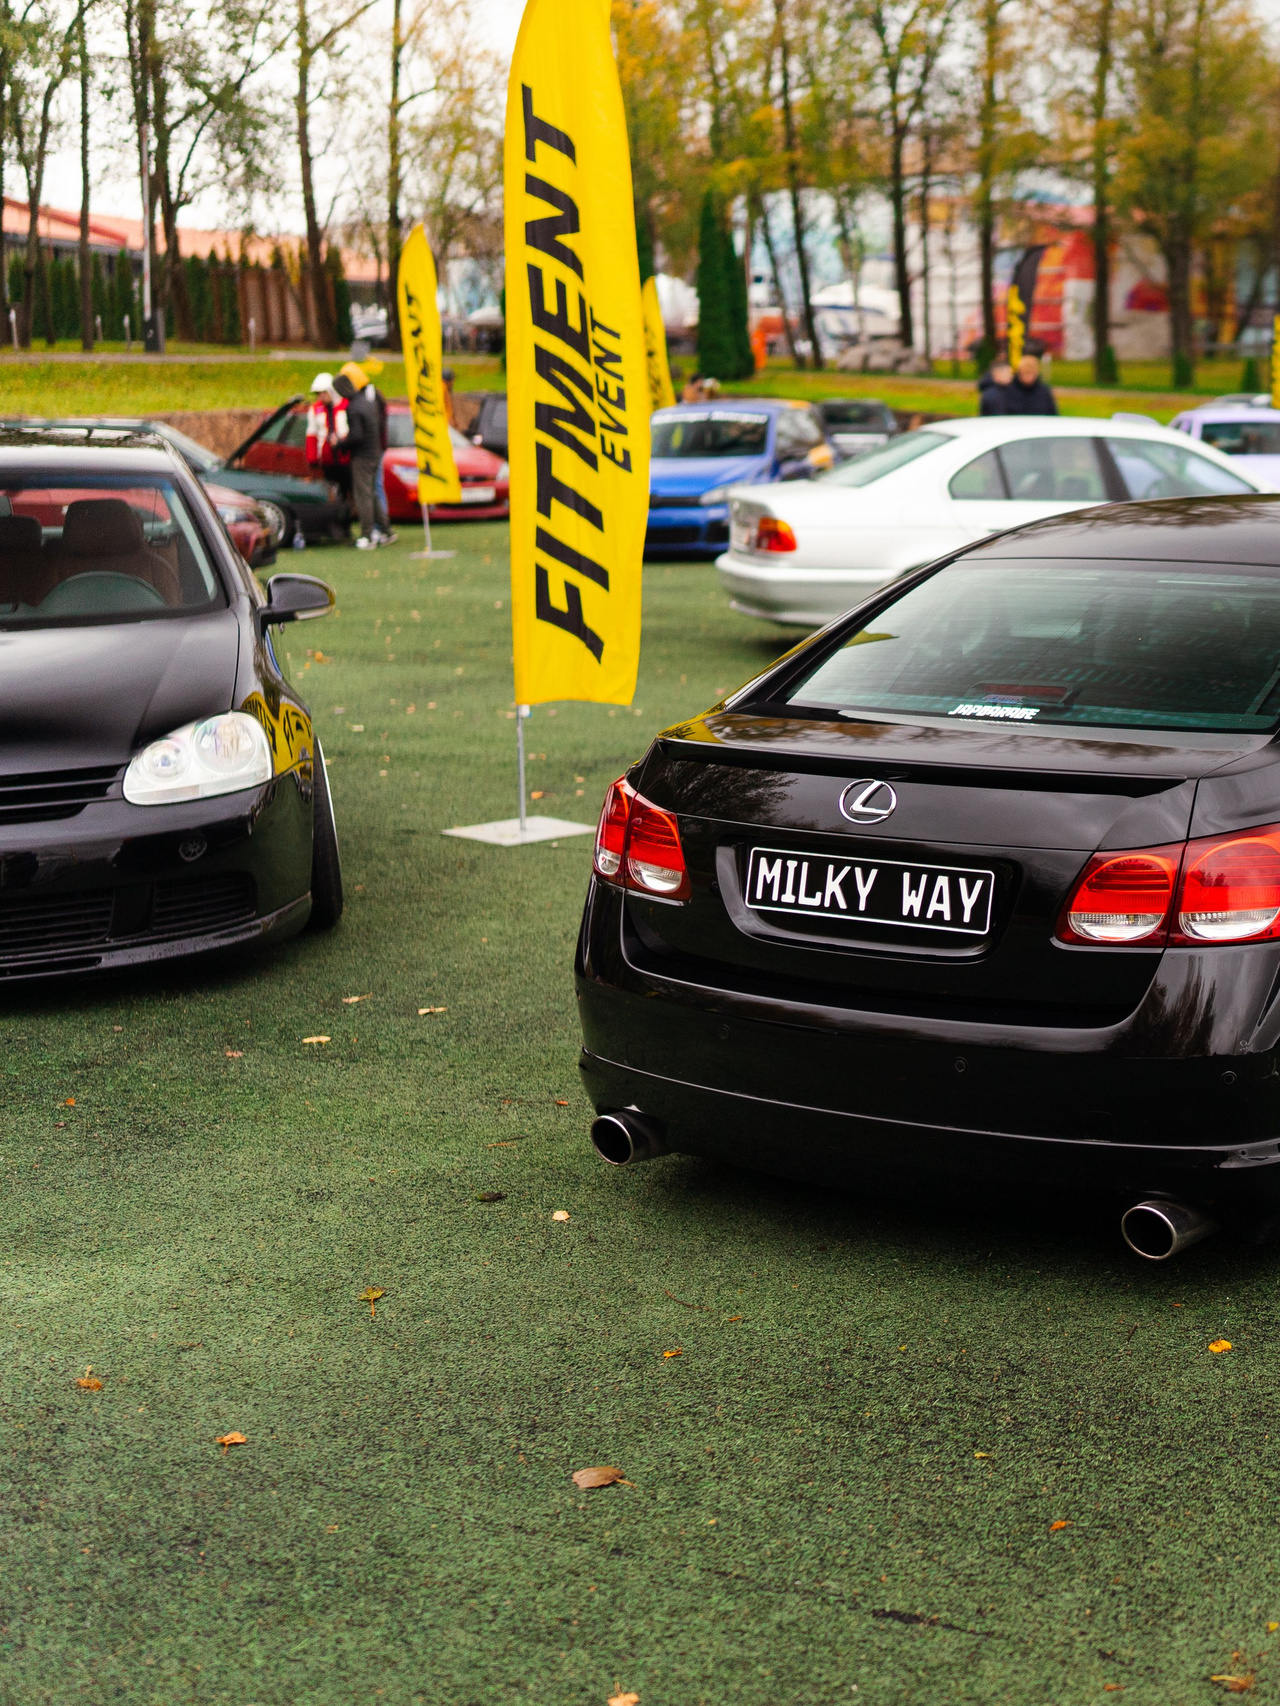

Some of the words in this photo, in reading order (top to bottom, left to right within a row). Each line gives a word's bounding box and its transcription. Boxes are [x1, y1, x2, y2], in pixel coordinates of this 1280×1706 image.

[521, 82, 610, 665] FITMENT
[590, 305, 633, 473] EVENT
[755, 856, 878, 912] MILKY
[902, 871, 985, 923] WAY
